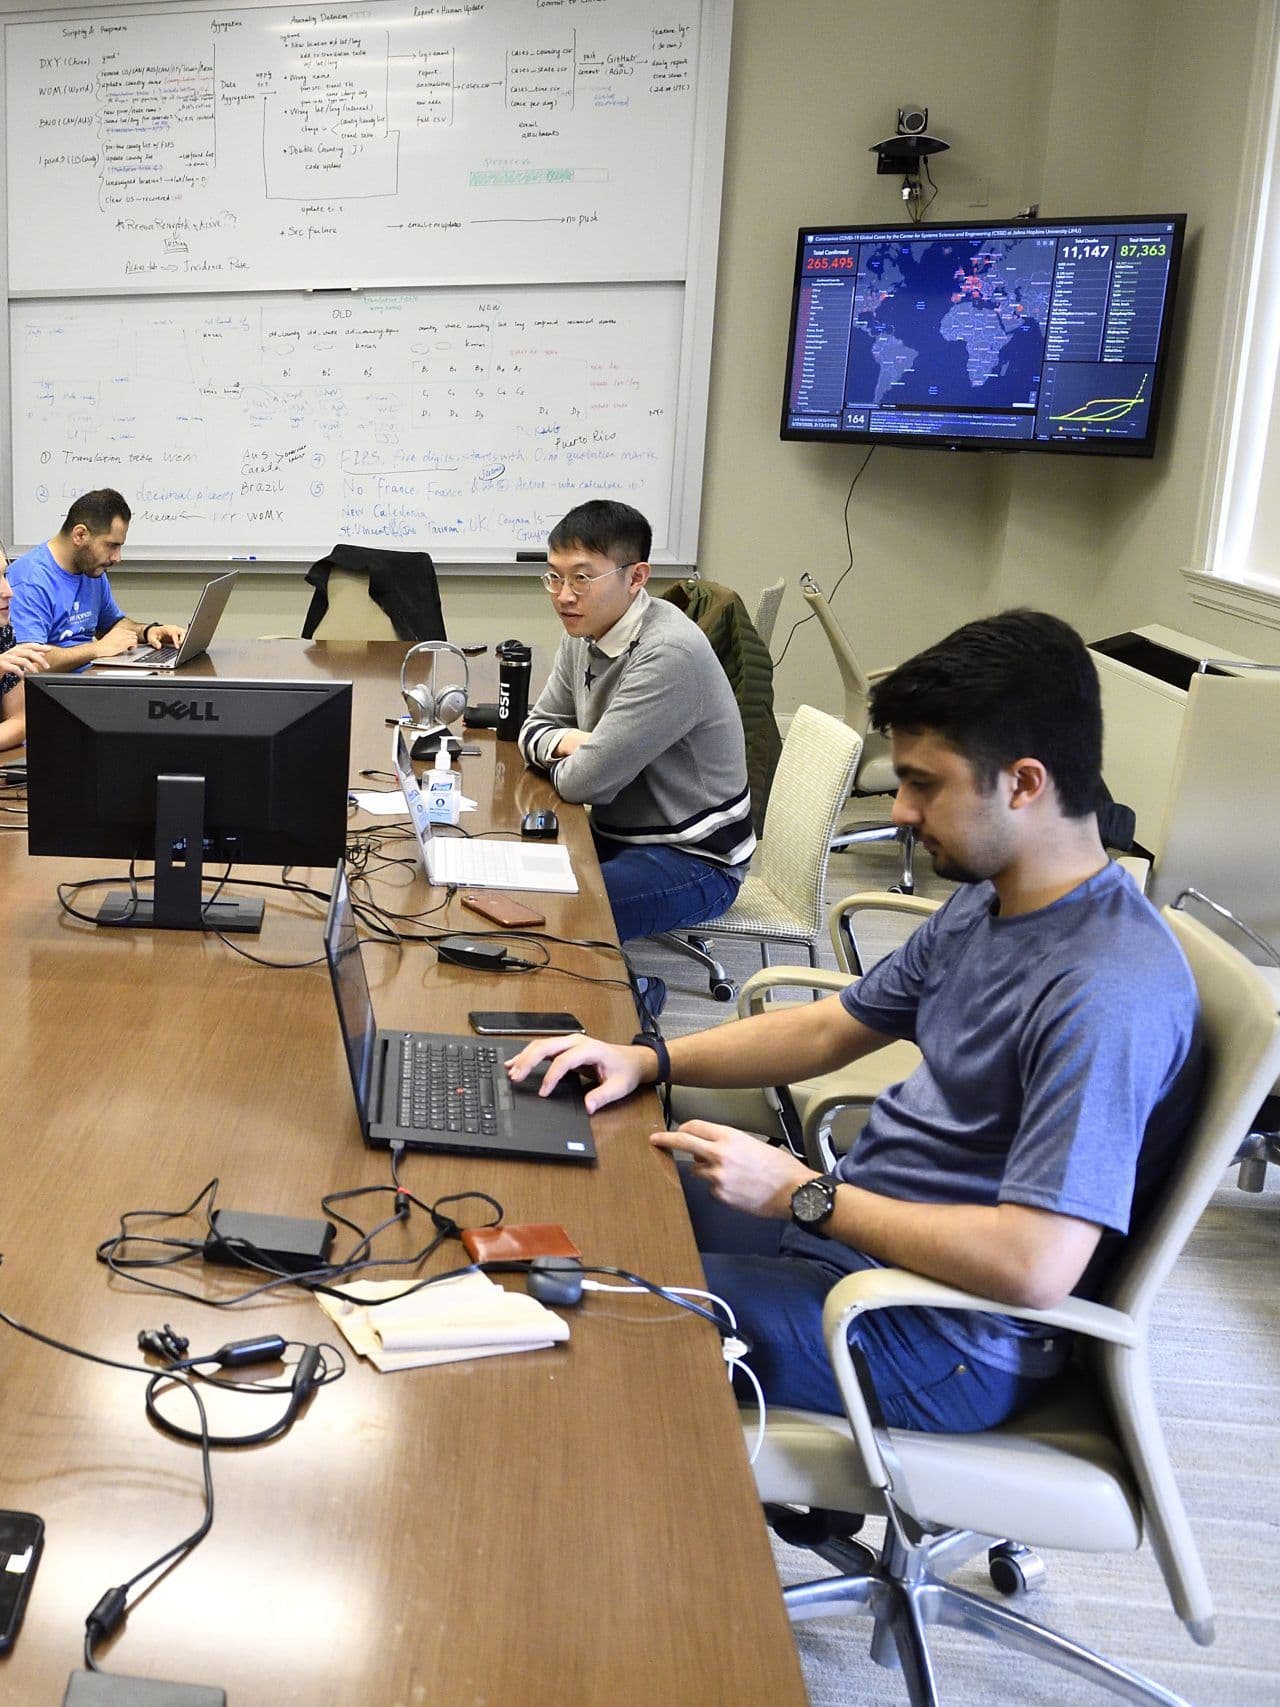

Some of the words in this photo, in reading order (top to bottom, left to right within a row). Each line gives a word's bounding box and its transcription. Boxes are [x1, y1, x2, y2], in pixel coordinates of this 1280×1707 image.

[40, 59, 61, 68] DXY
[39, 86, 61, 96] WOM
[1062, 246, 1109, 259] 11,147
[1120, 245, 1166, 258] 87,363
[807, 258, 854, 269] 265,495
[847, 415, 864, 424] 164
[555, 437, 588, 450] Puerto
[593, 430, 617, 443] Rico
[62, 450, 122, 464] Translation
[240, 481, 284, 496] Brazil
[499, 683, 510, 720] esri
[148, 700, 219, 721] DELL
